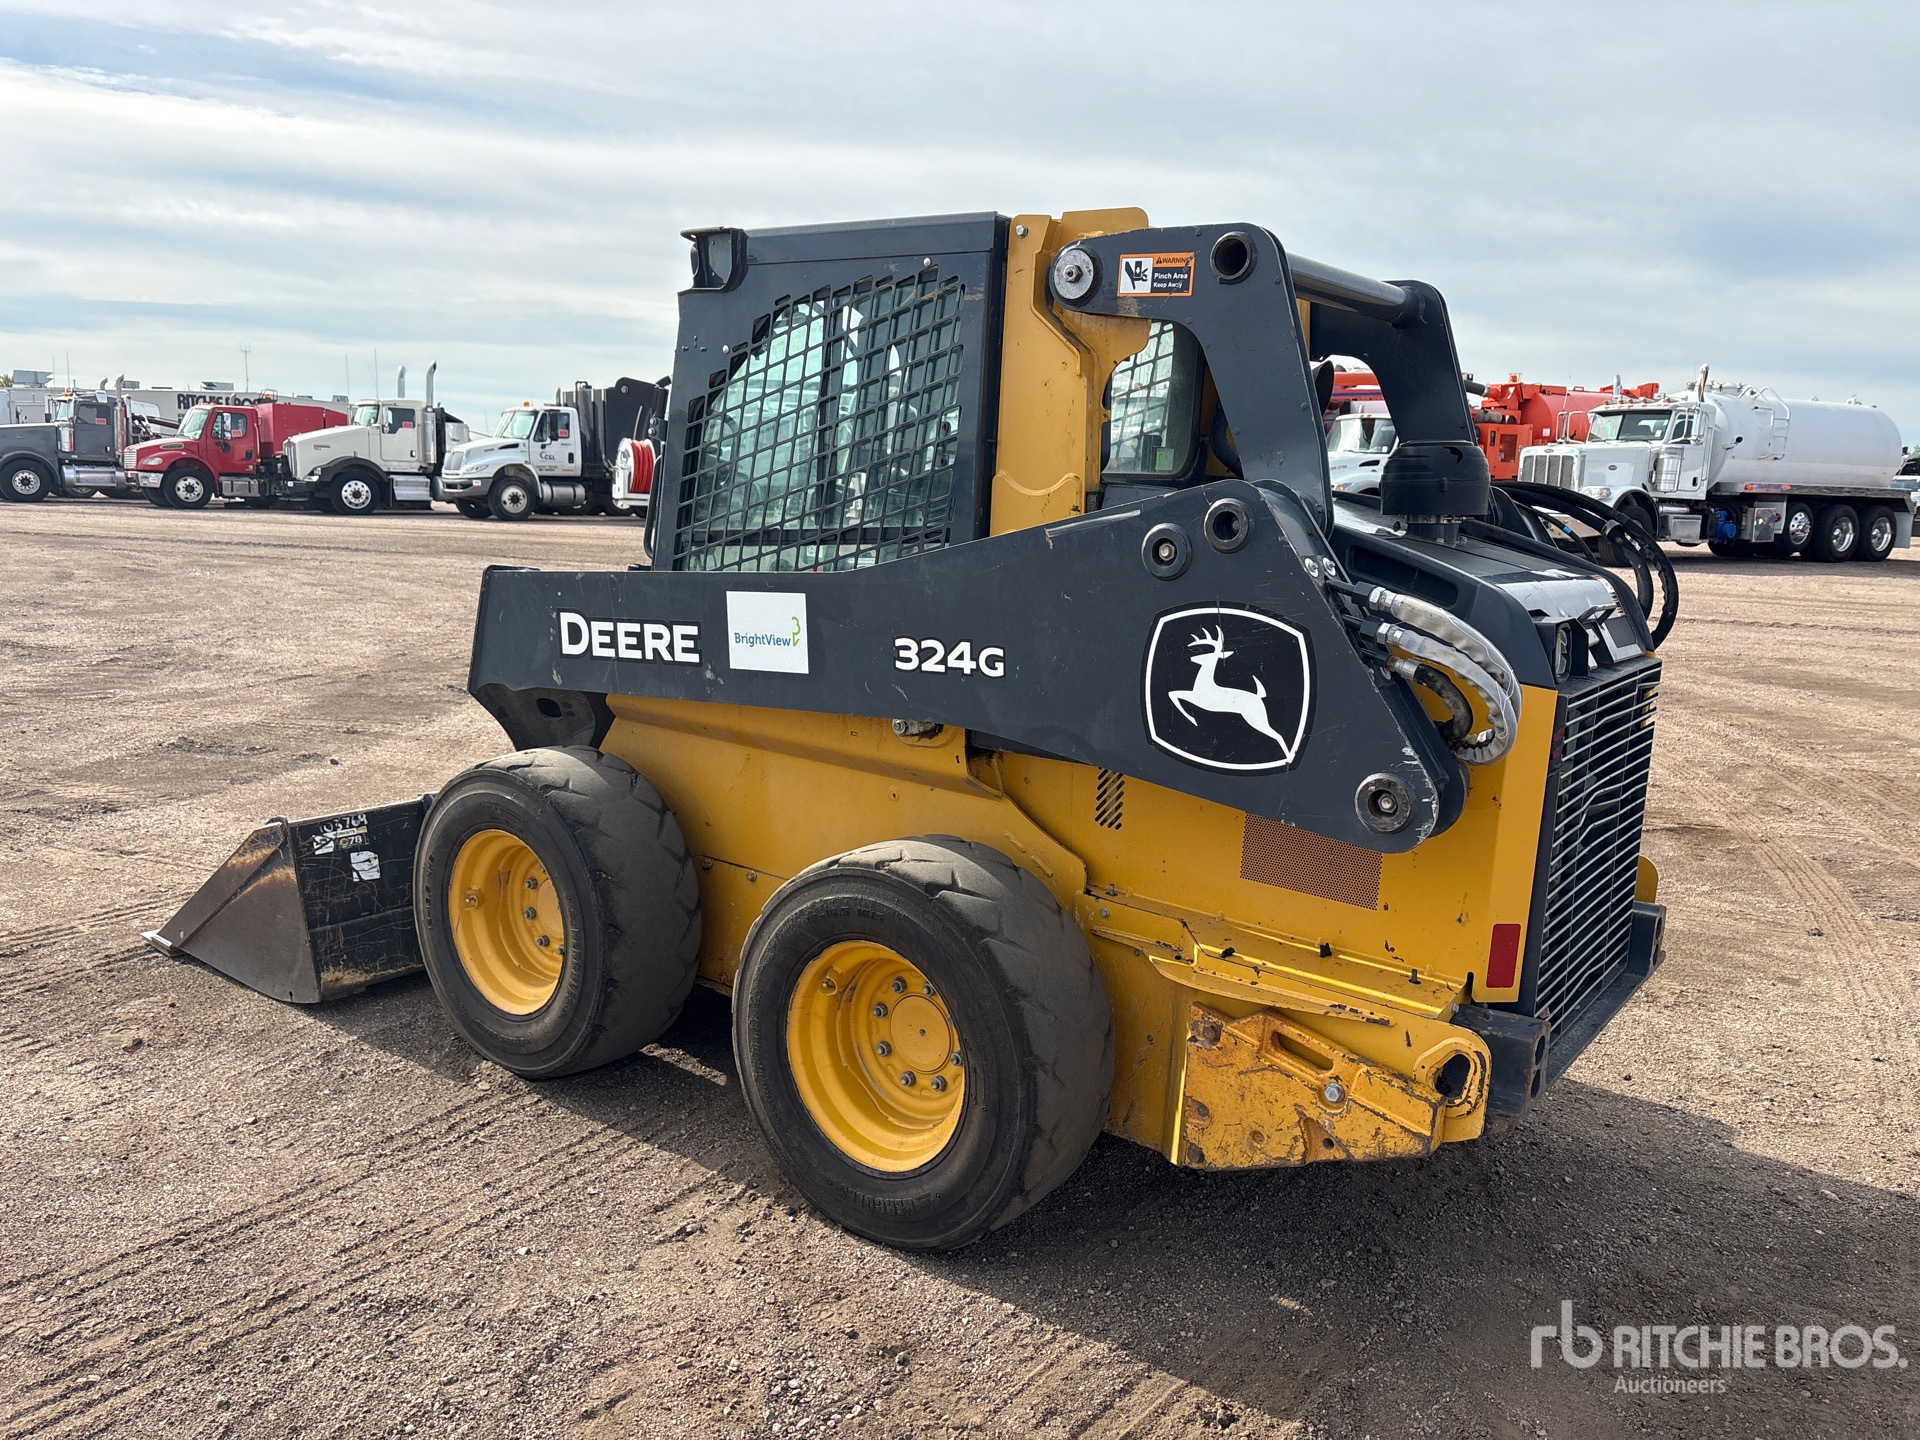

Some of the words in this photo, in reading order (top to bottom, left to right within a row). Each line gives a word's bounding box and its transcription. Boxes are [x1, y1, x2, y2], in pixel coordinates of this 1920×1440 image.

[1153, 281, 1167, 289] Keep
[1168, 281, 1183, 289] Away
[560, 611, 700, 662] DEERE
[734, 632, 791, 647] BrightView
[894, 637, 1005, 677] 324G
